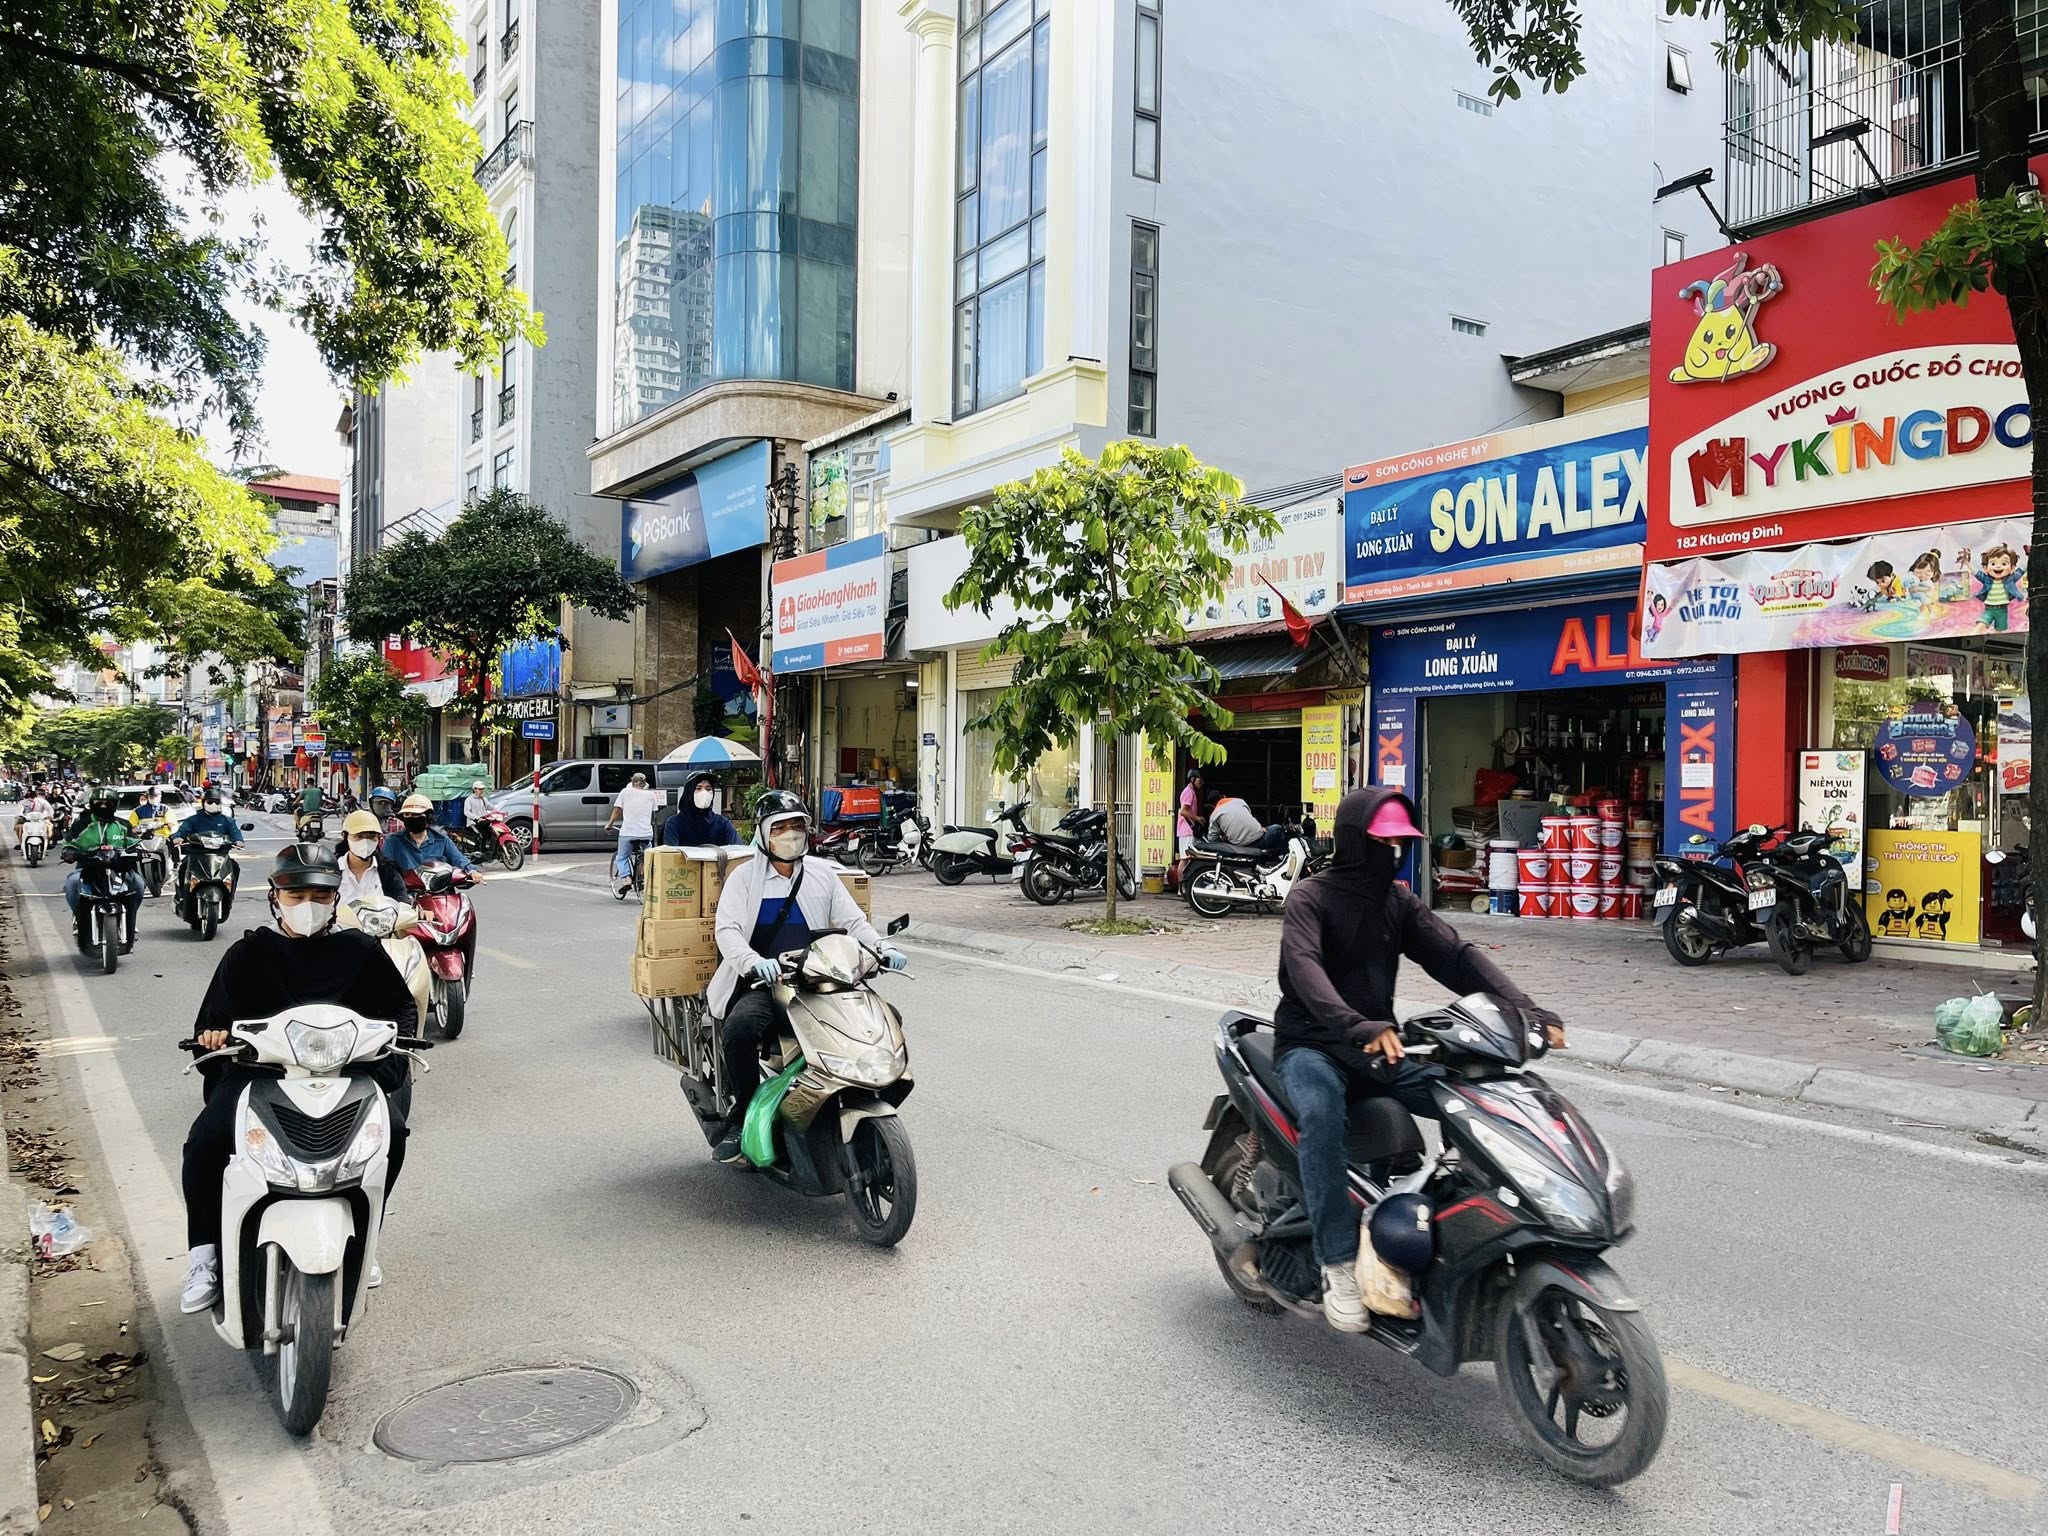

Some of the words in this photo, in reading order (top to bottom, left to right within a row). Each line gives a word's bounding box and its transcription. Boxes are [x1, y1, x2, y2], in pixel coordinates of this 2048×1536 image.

[1767, 380, 1845, 421] VƯƠNG
[1853, 358, 1920, 390] QUỐC
[1928, 352, 1962, 377] ĐỒ
[1375, 463, 1399, 478] SƠN
[1401, 456, 1434, 473] CÔNG
[1436, 446, 1469, 465] NGHỆ
[1471, 442, 1489, 456] MỸ
[1430, 473, 1518, 554] SƠN
[1526, 444, 1649, 540] ALEX
[1370, 509, 1387, 526] ĐẠI
[1387, 503, 1398, 522] LÝ
[643, 507, 691, 547] PGBank
[1676, 535, 1698, 549] 182
[1700, 531, 1750, 546] Khương
[1752, 524, 1783, 540] Đình
[1356, 537, 1383, 559] LONG
[1384, 531, 1414, 555] XUÂN
[1294, 551, 1325, 579] TAY
[797, 577, 877, 612] GiaoHangNhanh
[1789, 578, 1832, 600] Tặng
[780, 616, 794, 630] GHN
[1411, 626, 1427, 634] CÔNG
[1446, 638, 1462, 652] ĐẠI
[1465, 634, 1476, 648] LÝ
[1425, 657, 1458, 677] LONG
[1461, 651, 1498, 674] XUÂN
[536, 699, 554, 716] BALI
[1681, 709, 1697, 717] LONG
[1698, 707, 1715, 716] XUÂN
[1810, 776, 1833, 787] NIỀM
[1824, 787, 1848, 798] LỚN
[1147, 848, 1164, 864] TAY
[1894, 841, 1927, 851] THÔNG
[1930, 843, 1946, 851] TIN
[1883, 851, 1902, 860] THÚ
[1905, 852, 1914, 863] VỊ
[1916, 851, 1928, 861] VỀ
[665, 890, 696, 898] SUN-UP
